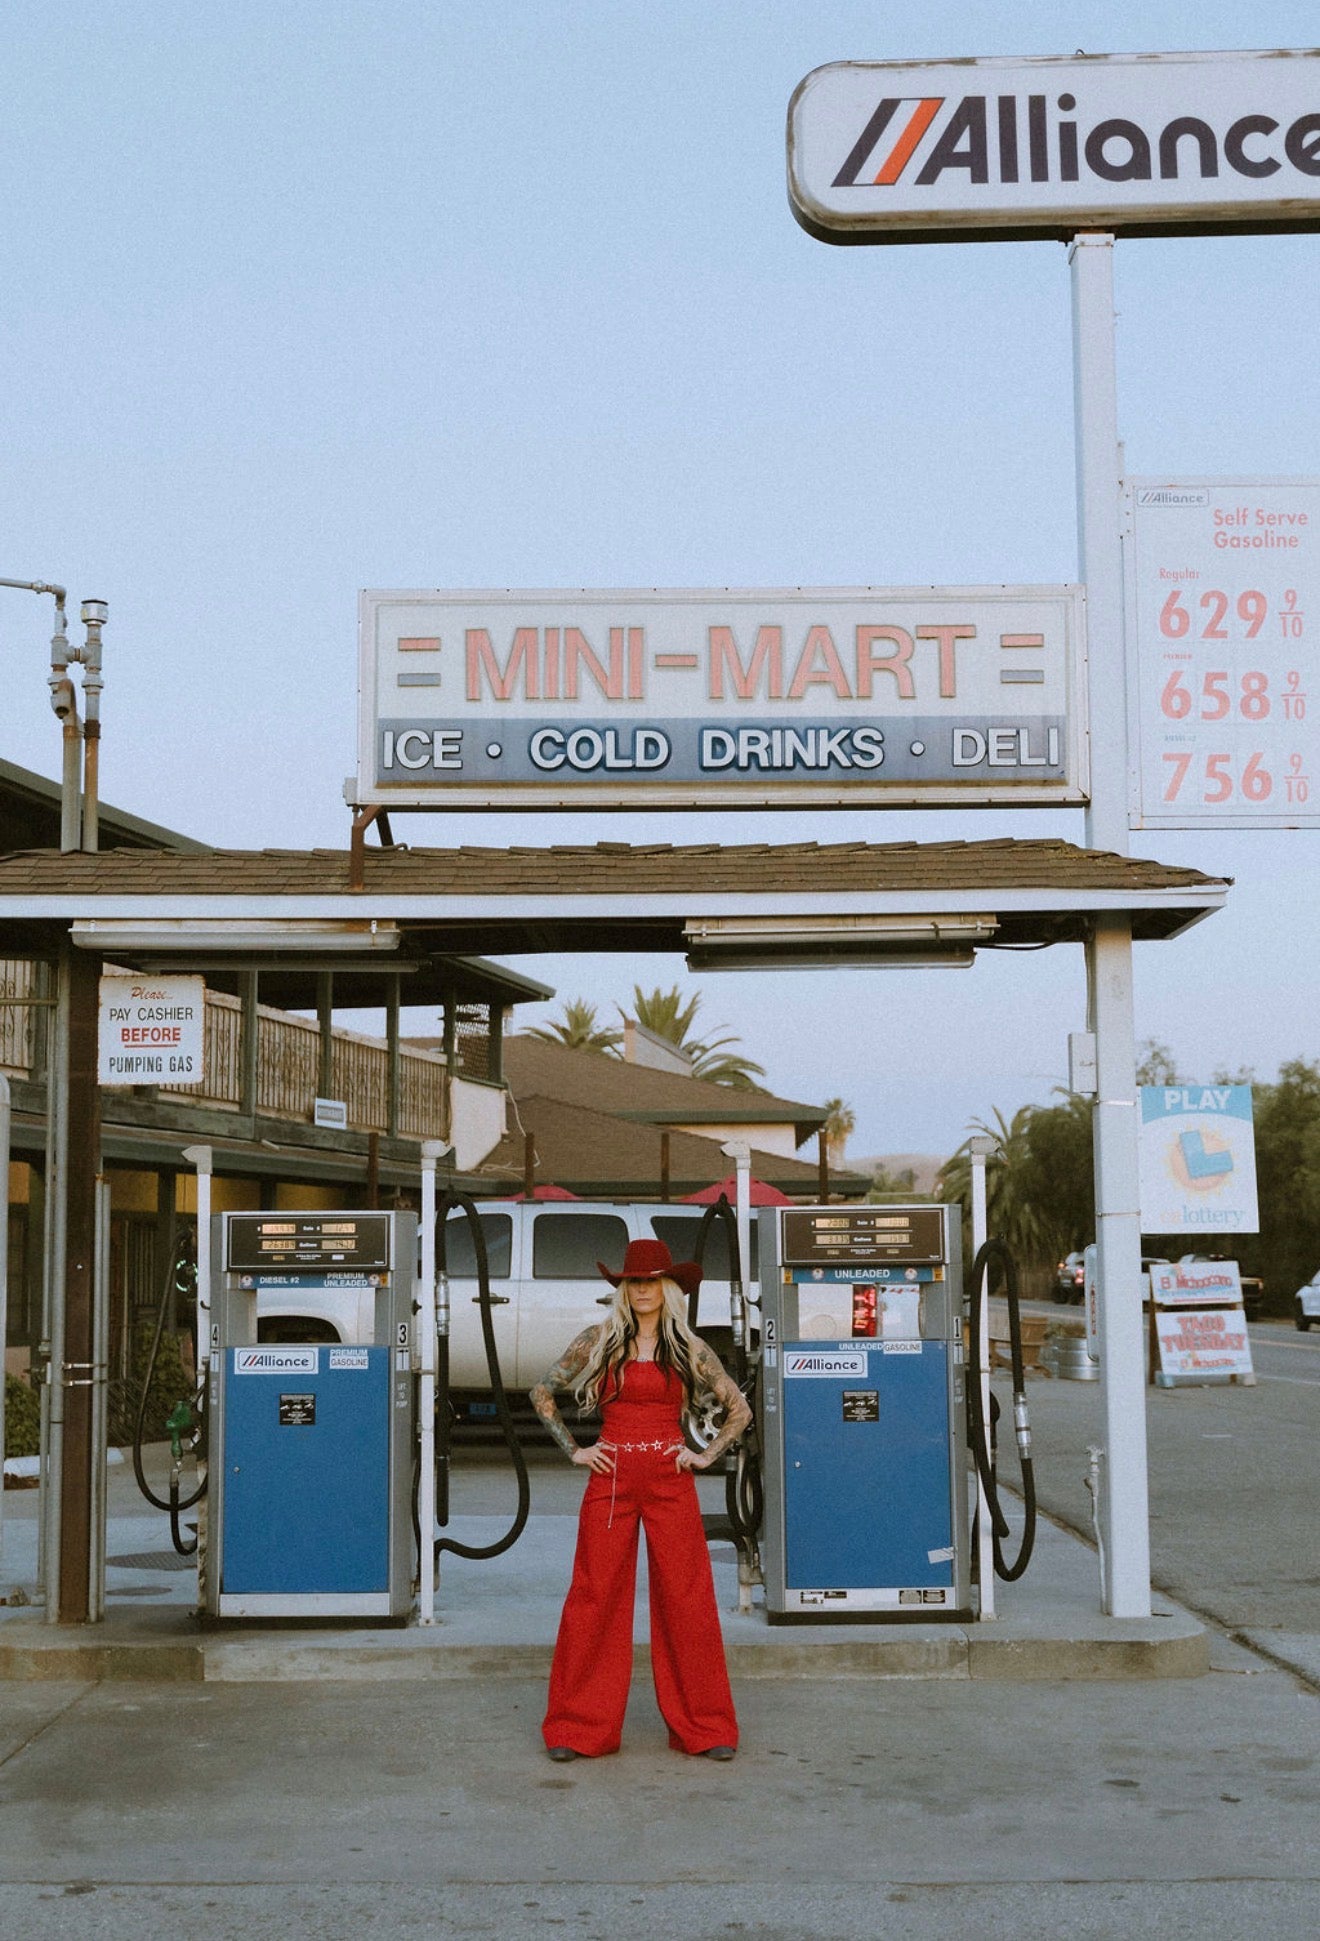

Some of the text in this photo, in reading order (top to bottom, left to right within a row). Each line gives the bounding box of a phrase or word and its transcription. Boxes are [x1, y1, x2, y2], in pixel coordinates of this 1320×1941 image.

[914, 92, 1320, 185] Alliance
[1153, 492, 1204, 503] Alliance
[1212, 508, 1309, 526] Self Serve
[1213, 530, 1299, 549] Gasoline
[1159, 567, 1199, 582] Regular
[1159, 589, 1268, 639] 629
[465, 625, 976, 700] MINI-MART
[1160, 670, 1271, 720] 658
[382, 727, 1059, 770] ICE COLD DRINKS DELI
[1162, 752, 1272, 803] 756
[109, 1007, 193, 1021] PAY CASHIER
[121, 1027, 181, 1042] BEFORE
[109, 1056, 193, 1073] PUMPING GAS
[1164, 1088, 1232, 1111] PLAY
[259, 1276, 289, 1285] DIESEL
[834, 1269, 891, 1279] UNLEADED
[323, 1279, 368, 1287] UNLEADED
[767, 1320, 774, 1340] 2
[954, 1318, 960, 1338] 1
[1176, 1315, 1226, 1332] TACO
[212, 1326, 218, 1343] 4
[399, 1324, 407, 1344] 3
[1162, 1333, 1246, 1352] TUESDAY
[838, 1342, 884, 1351] UNLEADED
[256, 1354, 310, 1367] Alliance
[331, 1358, 368, 1366] GASOLINE
[803, 1358, 858, 1370] Alliance
